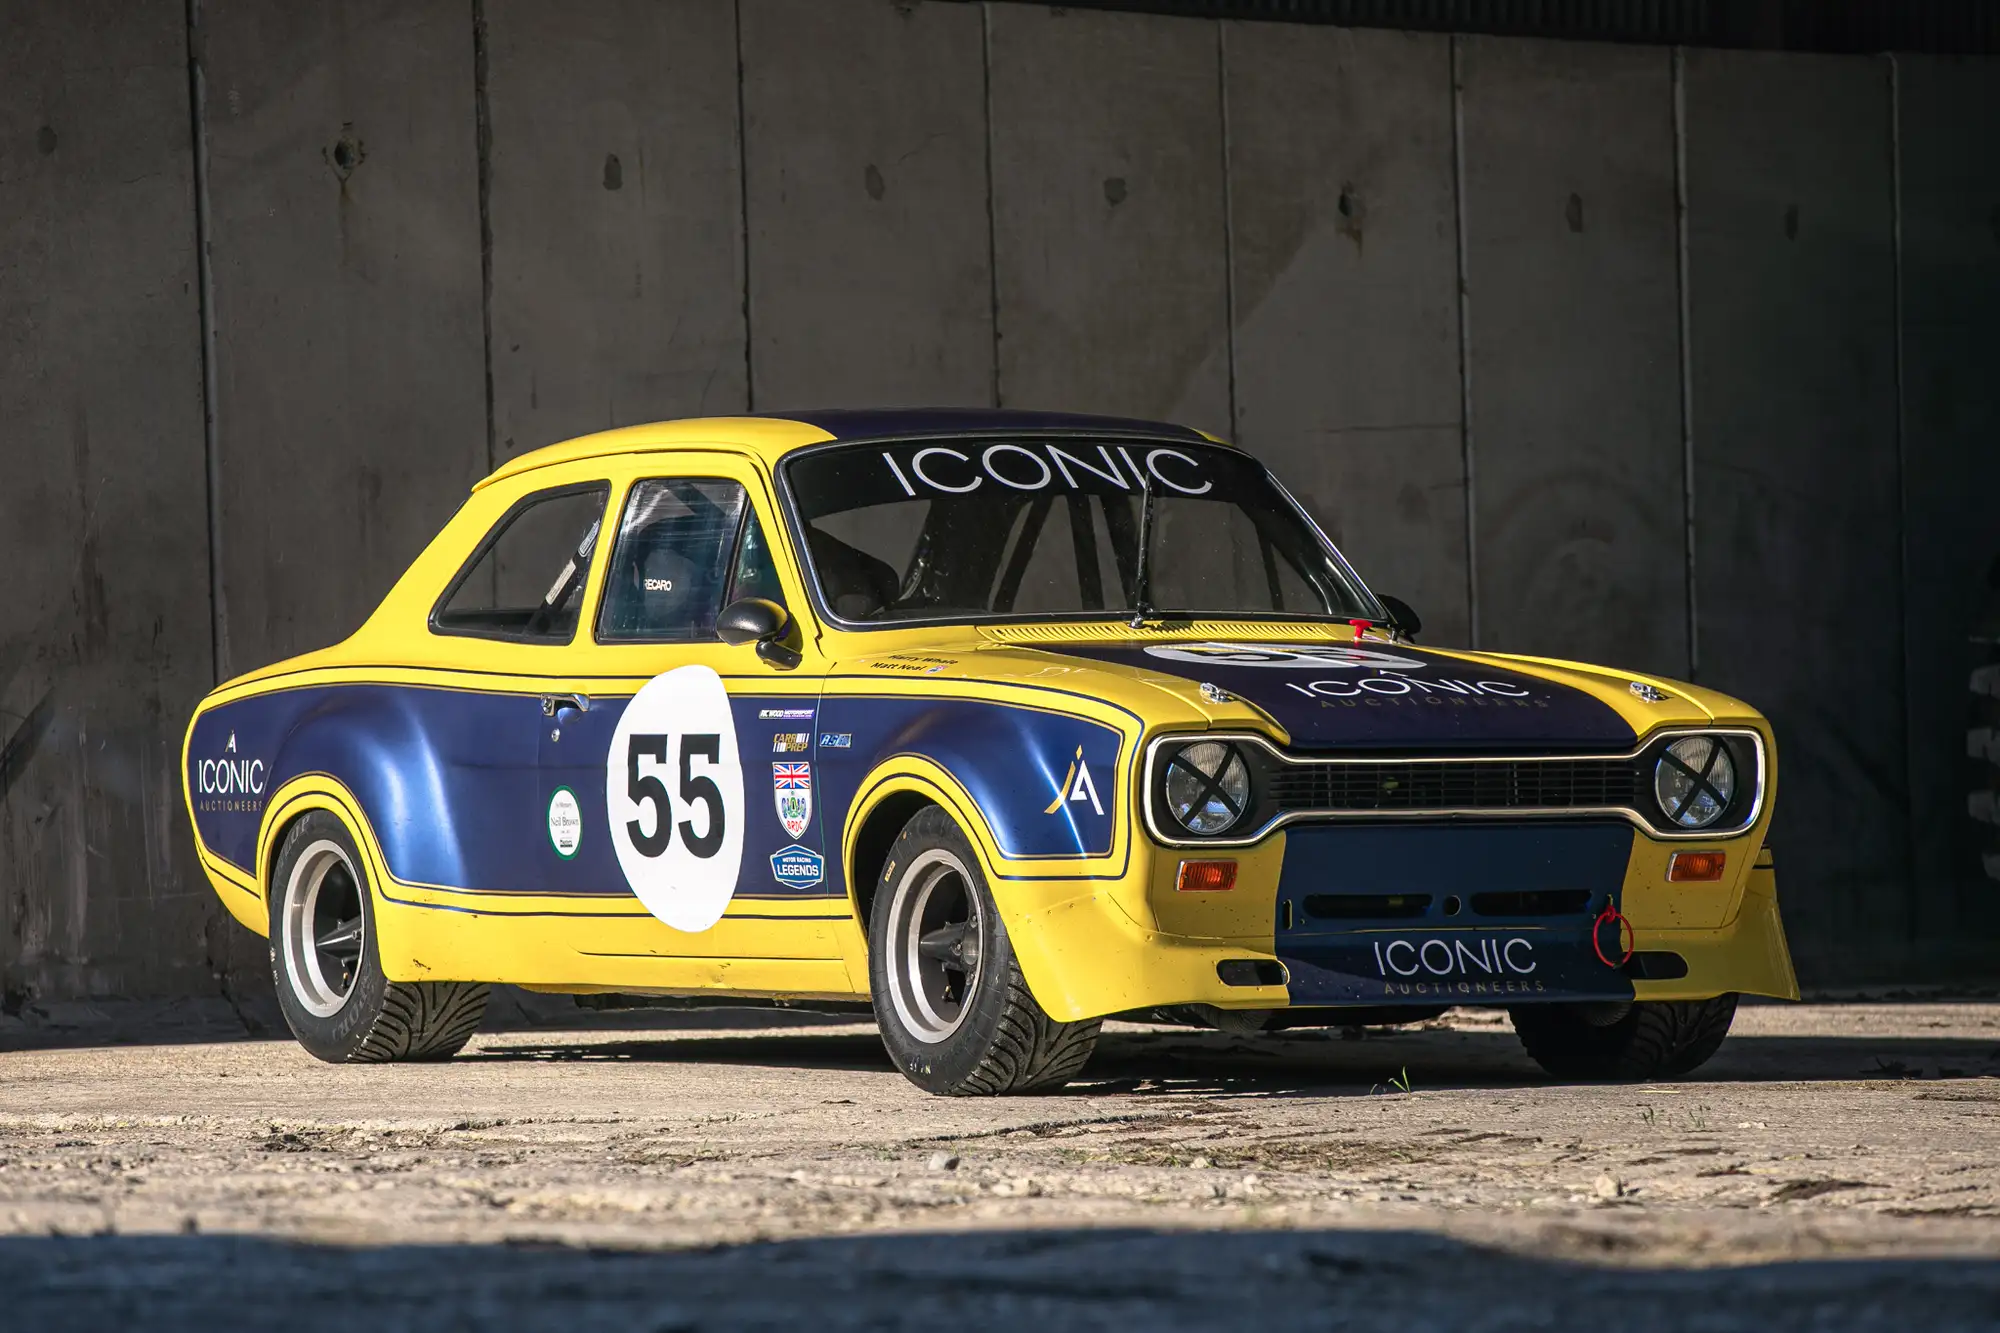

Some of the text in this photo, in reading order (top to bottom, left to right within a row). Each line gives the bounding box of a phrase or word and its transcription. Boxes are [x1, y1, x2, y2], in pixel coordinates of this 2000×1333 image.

[882, 444, 1212, 496] ICONIC
[1286, 678, 1529, 697] ICONIC
[1320, 696, 1549, 709] AUCTIONEERS
[773, 733, 797, 743] CARR
[785, 742, 808, 752] PREP
[198, 758, 264, 795] ICONIC
[626, 734, 725, 859] 55
[200, 800, 262, 812] AUCTIONEERS
[562, 816, 579, 827] Brown
[786, 820, 803, 832] BRDC
[777, 864, 819, 876] LEGENDS
[1374, 938, 1536, 976] ICONIC
[1384, 980, 1544, 995] AUCTIONEERS
